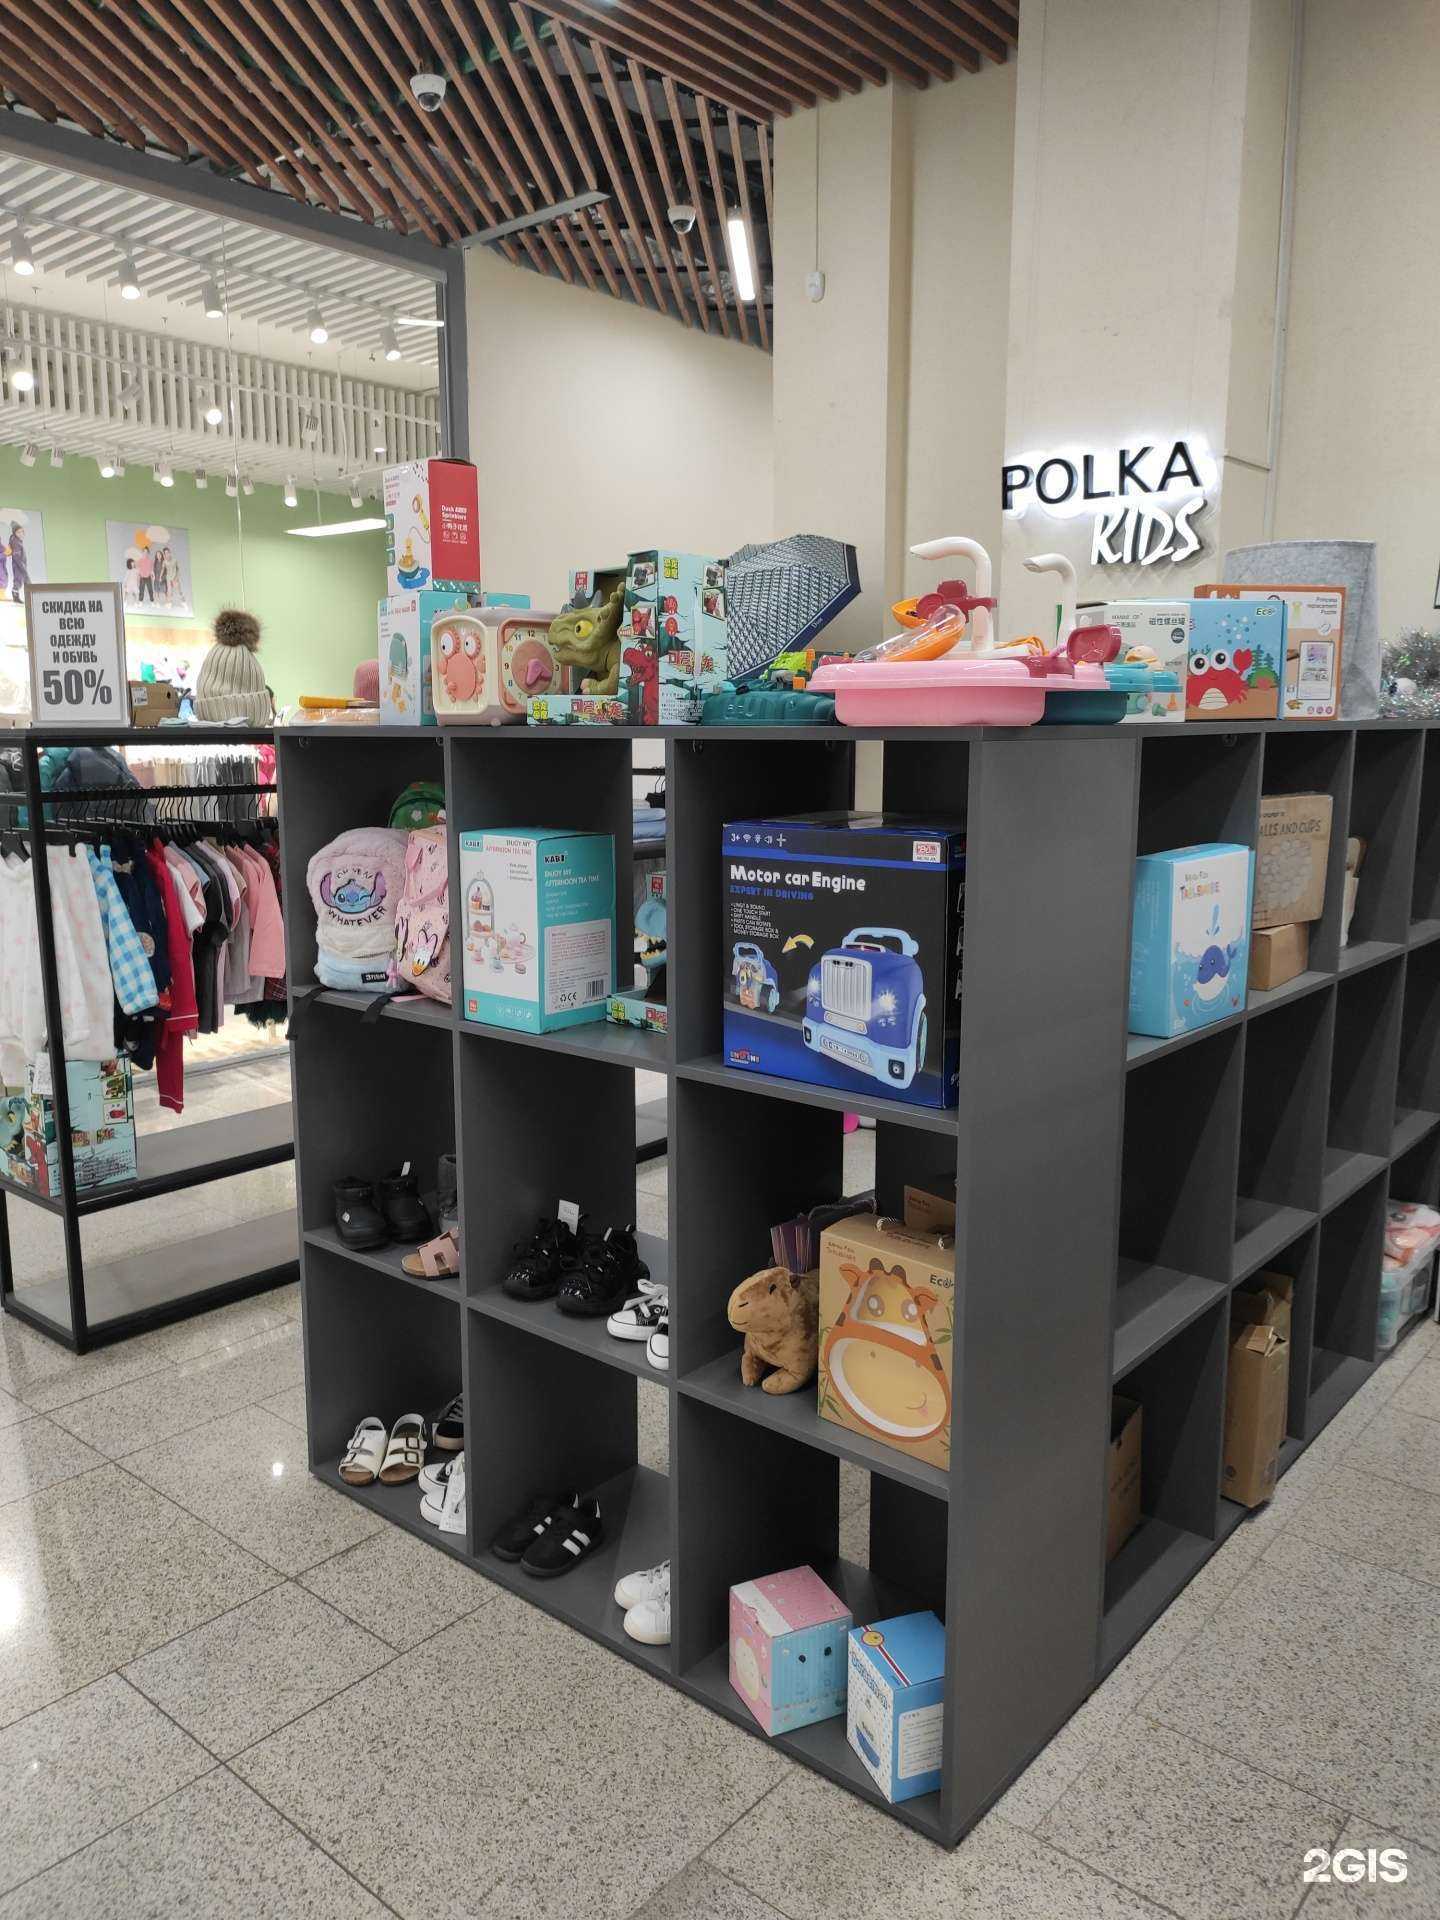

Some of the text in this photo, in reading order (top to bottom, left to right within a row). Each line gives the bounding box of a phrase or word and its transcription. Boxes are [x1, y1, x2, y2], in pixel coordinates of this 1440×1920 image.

[1002, 441, 1202, 510] POLKA
[1091, 496, 1207, 566] KIDS
[41, 600, 103, 615] СКИДКА НА
[59, 617, 85, 630] ВСЮ
[527, 629, 536, 638] 12
[49, 634, 96, 648] ОДЕЖДУ
[53, 651, 98, 664] И ОБУВЬ
[504, 662, 510, 670] 9
[43, 669, 112, 705] 50%
[544, 877, 577, 888] AFTERNOON
[730, 864, 866, 893] Motor car Engine
[775, 888, 814, 900] DRIVING
[328, 905, 387, 927] WHATEVER
